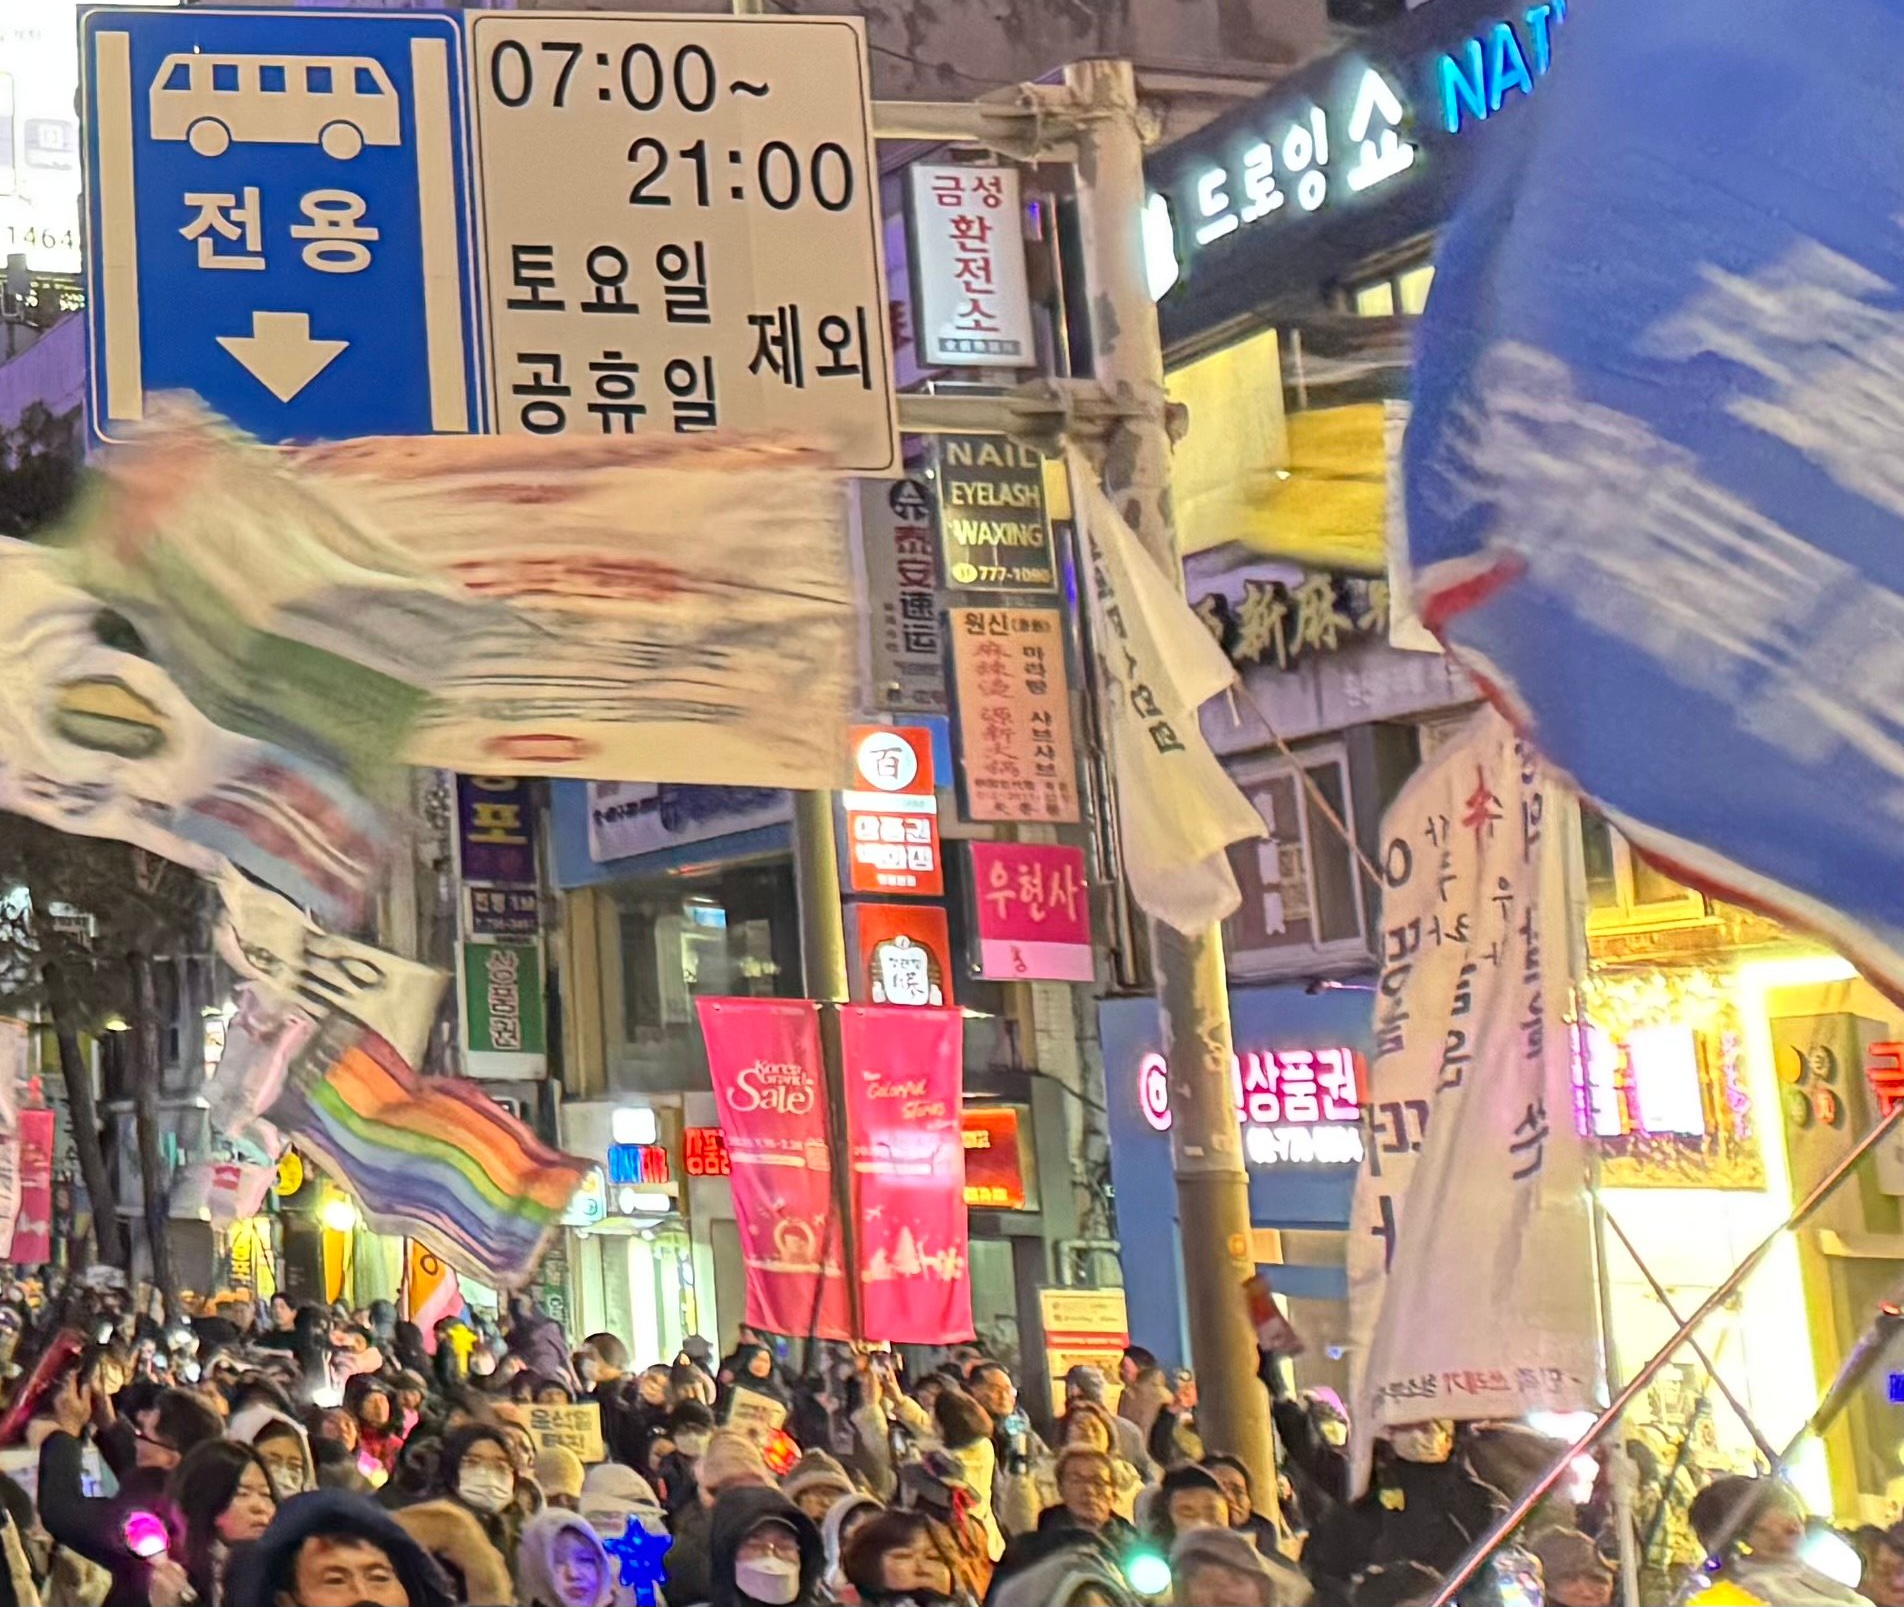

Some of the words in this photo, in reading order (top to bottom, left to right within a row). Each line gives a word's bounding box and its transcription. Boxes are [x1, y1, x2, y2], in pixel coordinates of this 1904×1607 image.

[489, 39, 772, 113] 07:00~
[625, 136, 856, 213] 21:00
[931, 174, 1004, 209] 금성
[177, 185, 381, 275] 전용
[505, 240, 711, 325] 토요일
[948, 213, 1002, 334] 환전소
[746, 304, 875, 392] 제외
[510, 349, 720, 436] 공휴일
[947, 442, 1040, 470] NAIL
[951, 480, 1041, 508] EYELASH
[950, 519, 1044, 548] WAXING
[870, 746, 903, 781] 百
[986, 859, 1080, 923] 우현사
[727, 1066, 815, 1115] Sale
